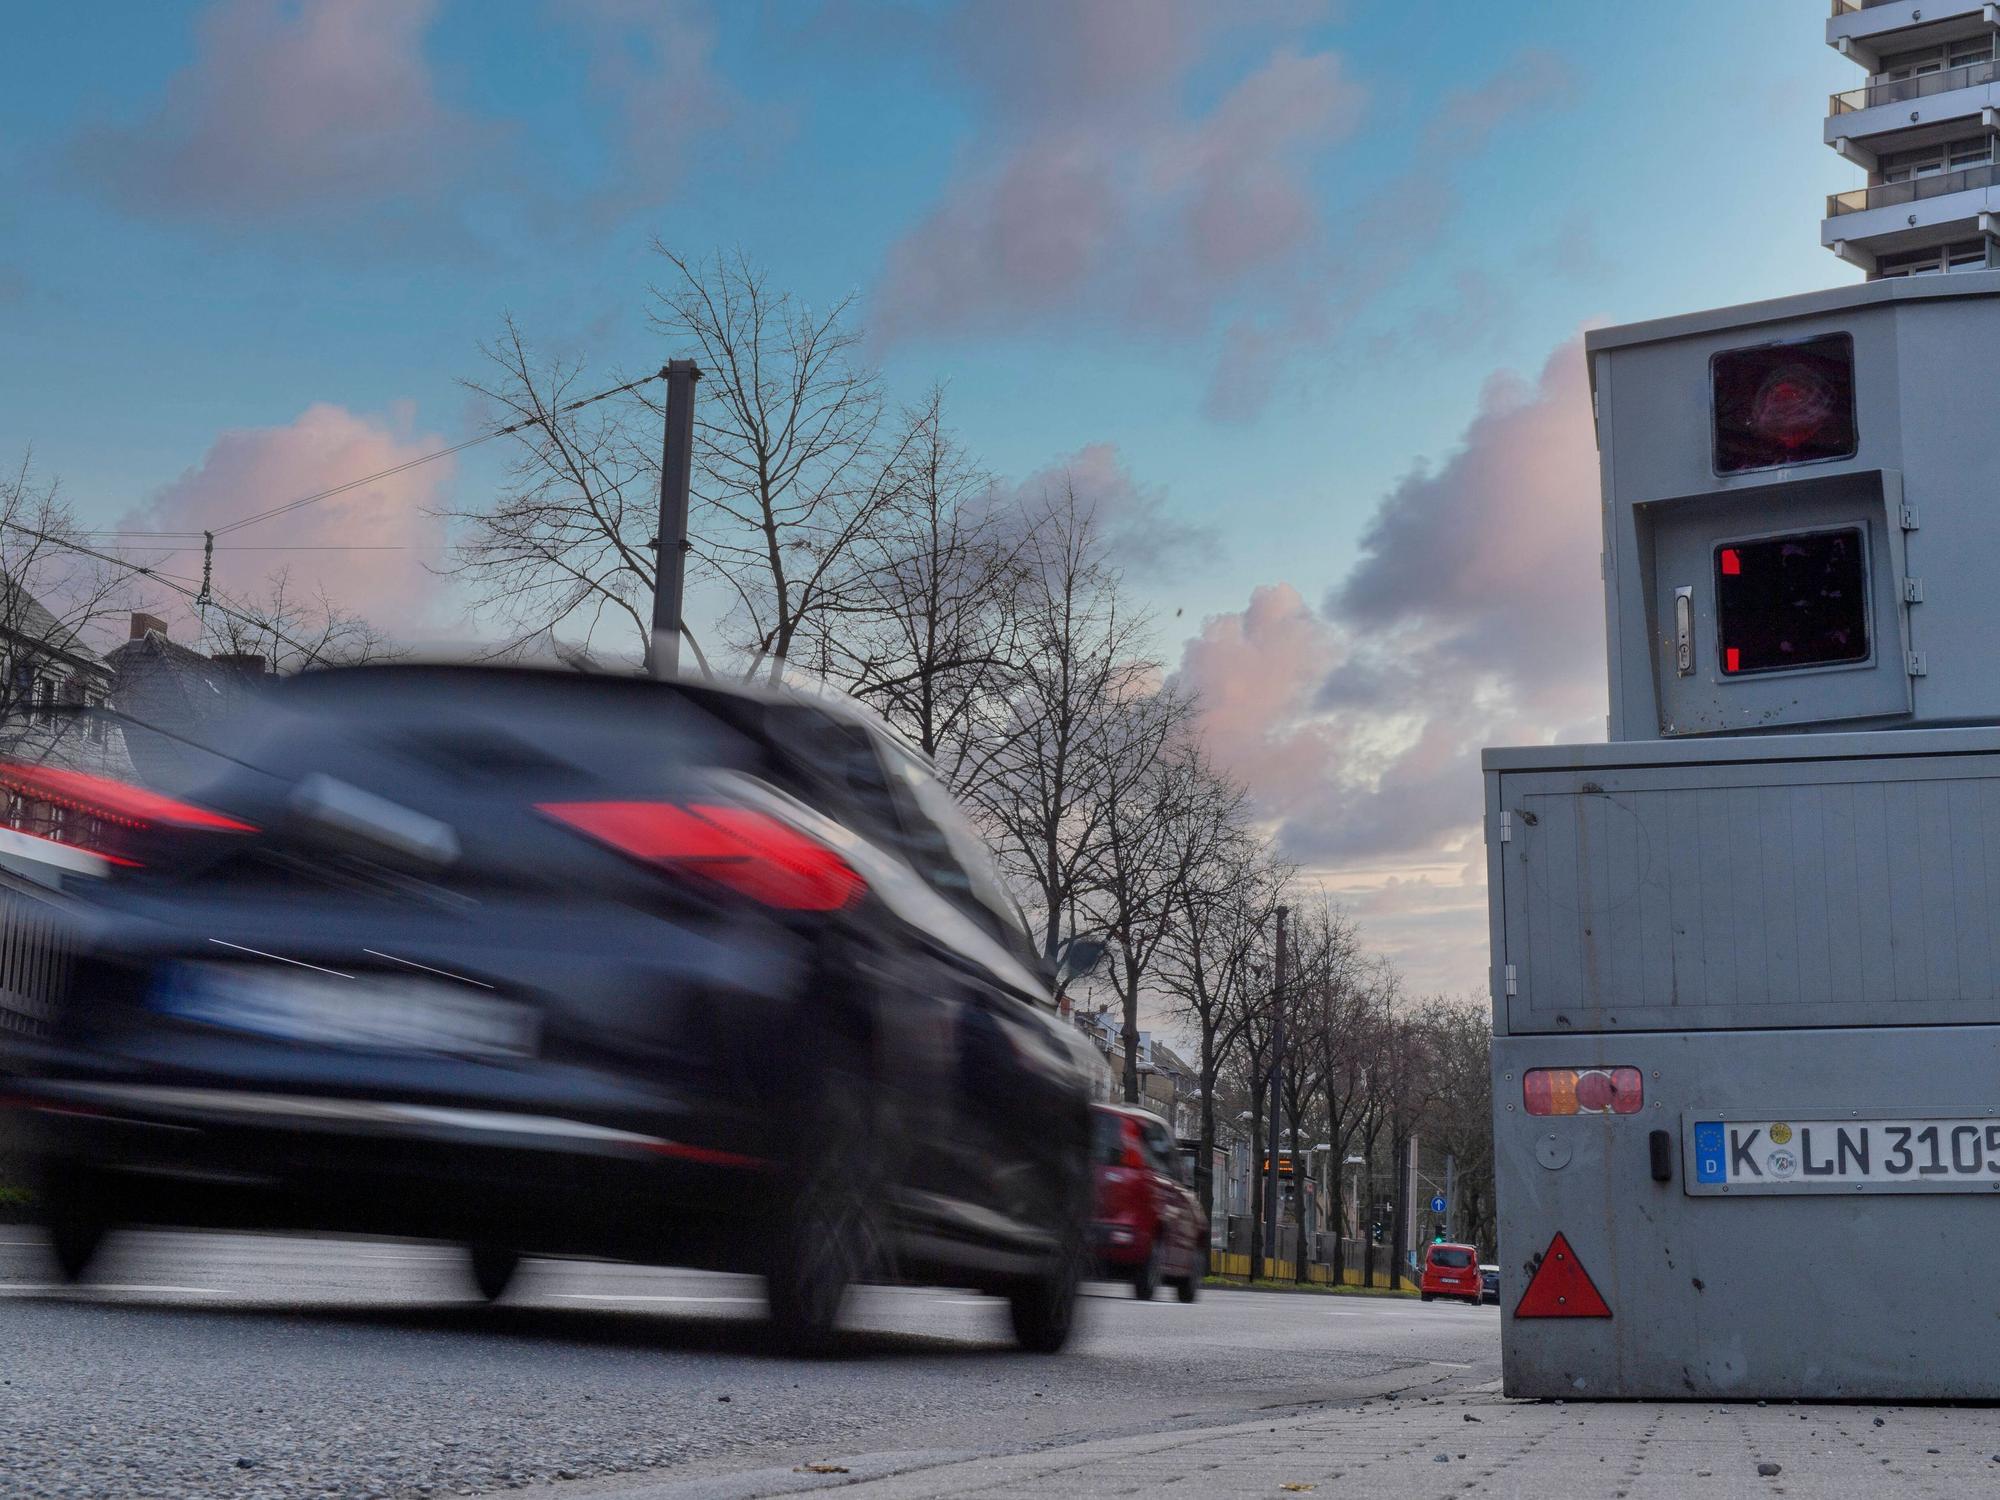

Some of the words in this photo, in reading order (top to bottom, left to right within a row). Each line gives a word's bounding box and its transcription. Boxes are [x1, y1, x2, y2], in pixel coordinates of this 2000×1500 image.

[1706, 1159, 1717, 1173] D
[1731, 1129, 1763, 1176] K
[1801, 1127, 1870, 1175] LN
